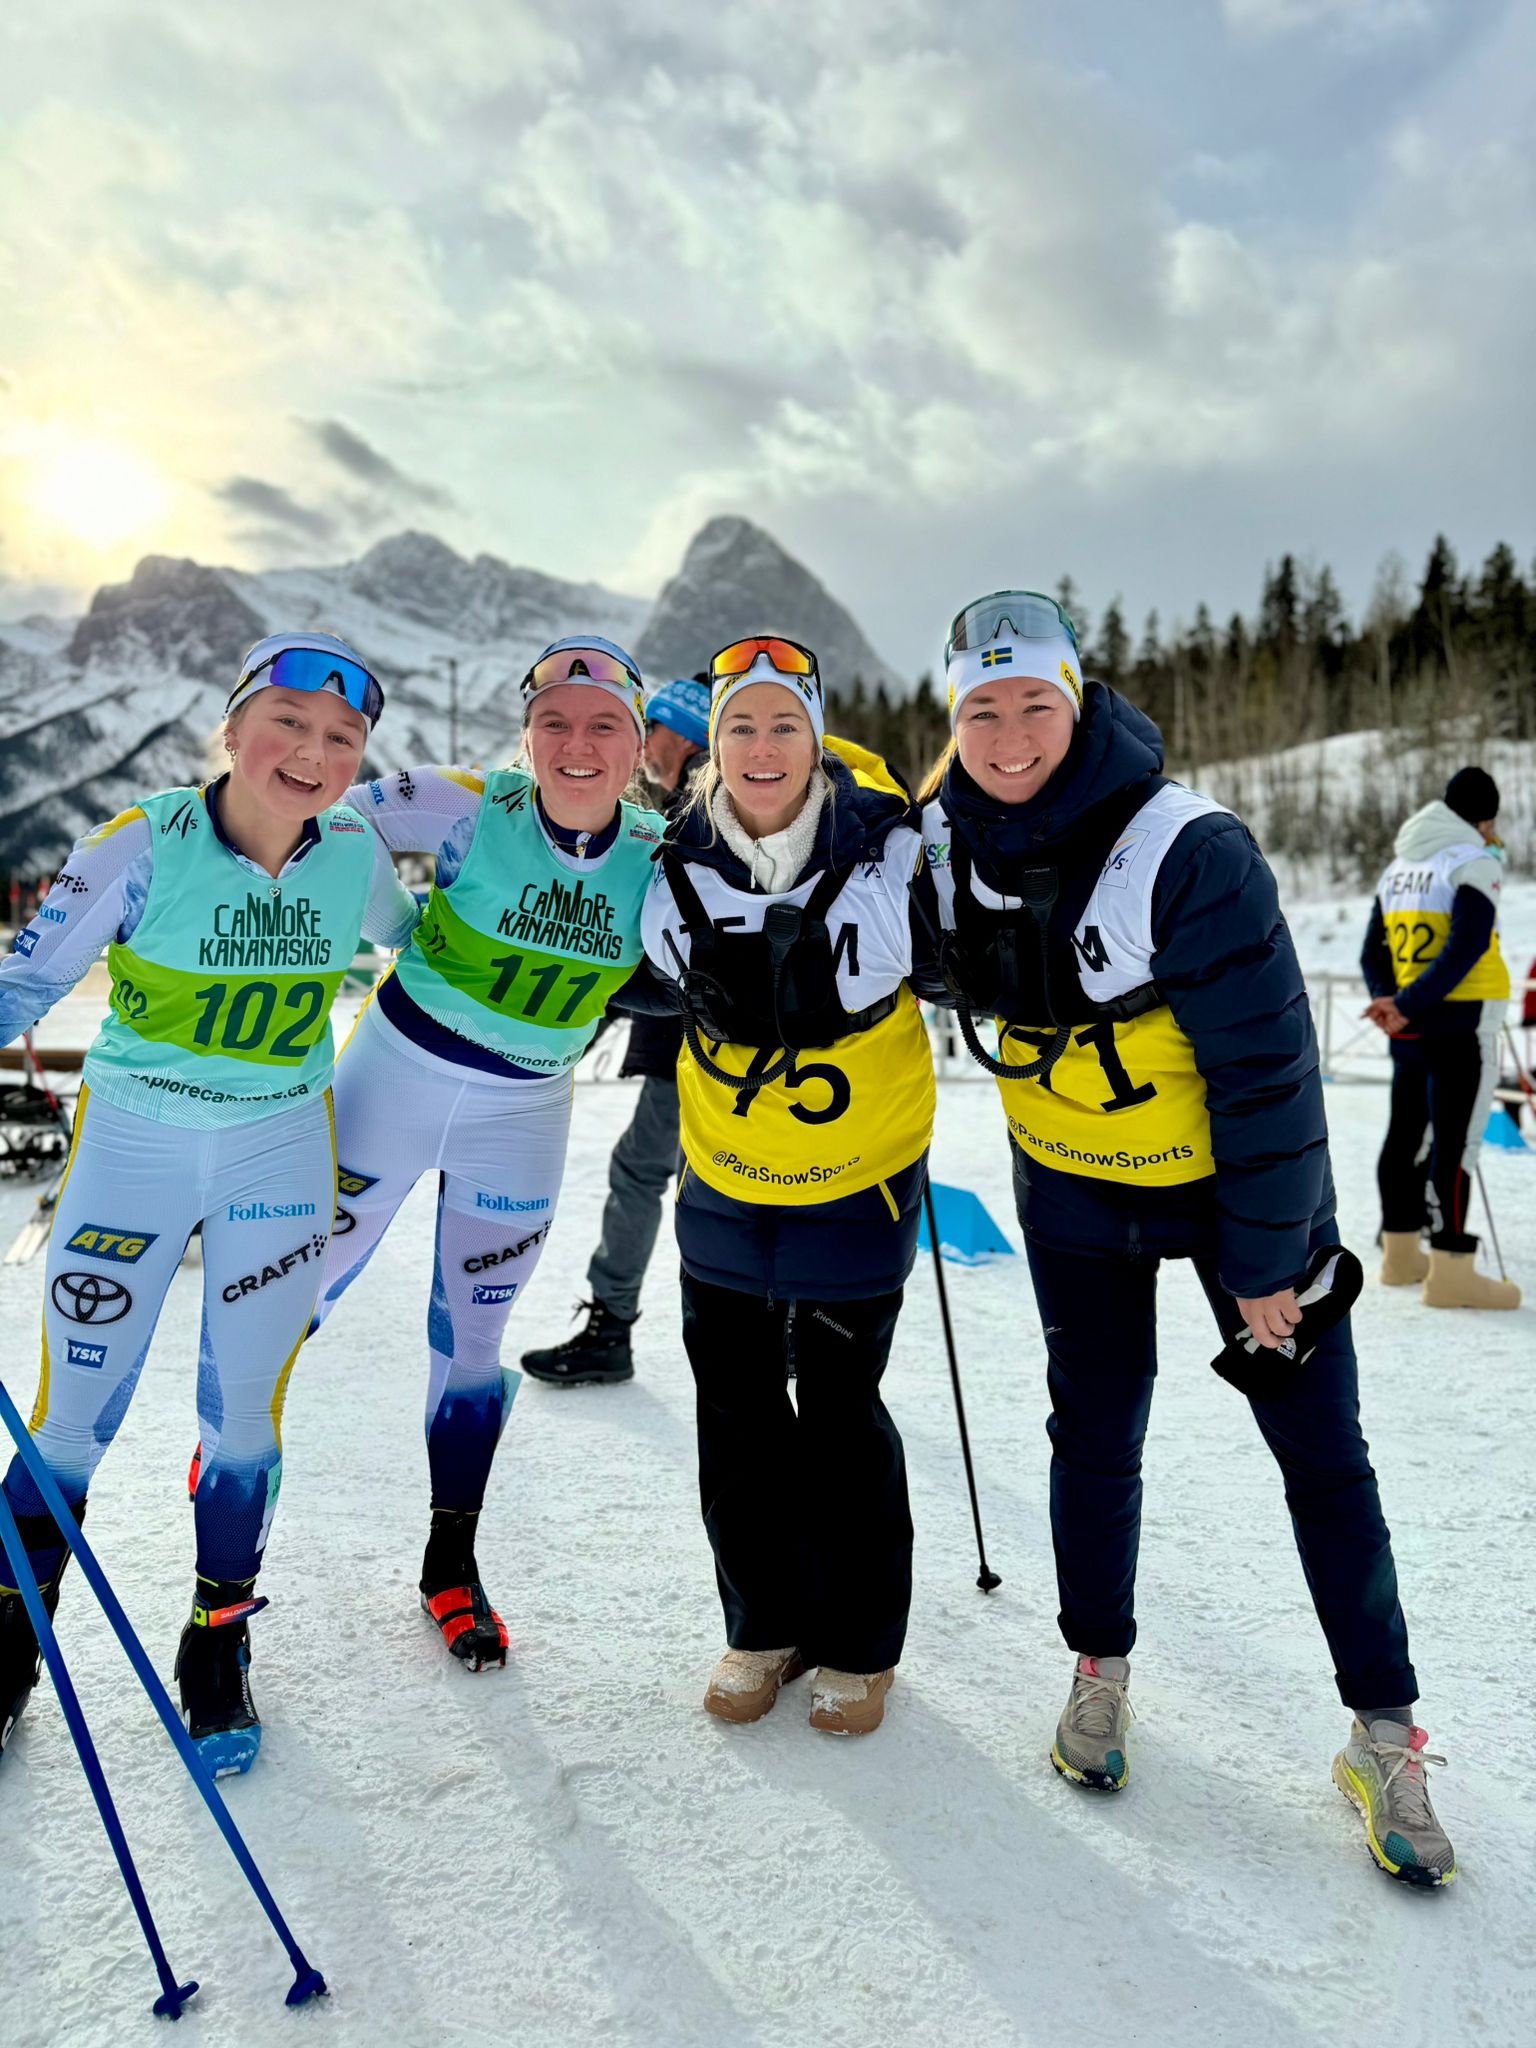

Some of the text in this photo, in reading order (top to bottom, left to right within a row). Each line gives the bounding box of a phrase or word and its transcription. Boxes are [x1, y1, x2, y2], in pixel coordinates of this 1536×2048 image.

[199, 938, 332, 966] KANANASKIS
[497, 908, 623, 960] KANANASKIS
[1395, 923, 1434, 963] 22
[488, 954, 601, 1022] 111
[193, 980, 325, 1058] 102
[1008, 1115, 1194, 1169] @ParaSnowSports
[228, 1202, 316, 1221] Folksam
[476, 1192, 549, 1211] Folksam
[71, 1230, 146, 1257] ATG
[464, 1229, 543, 1274] CRAFT
[222, 1243, 311, 1303] CRAFT
[482, 1287, 514, 1300] JYSK
[819, 1312, 853, 1340] HOUDINI
[220, 1604, 255, 1619] SALOMON
[241, 1671, 255, 1719] SALOMON
